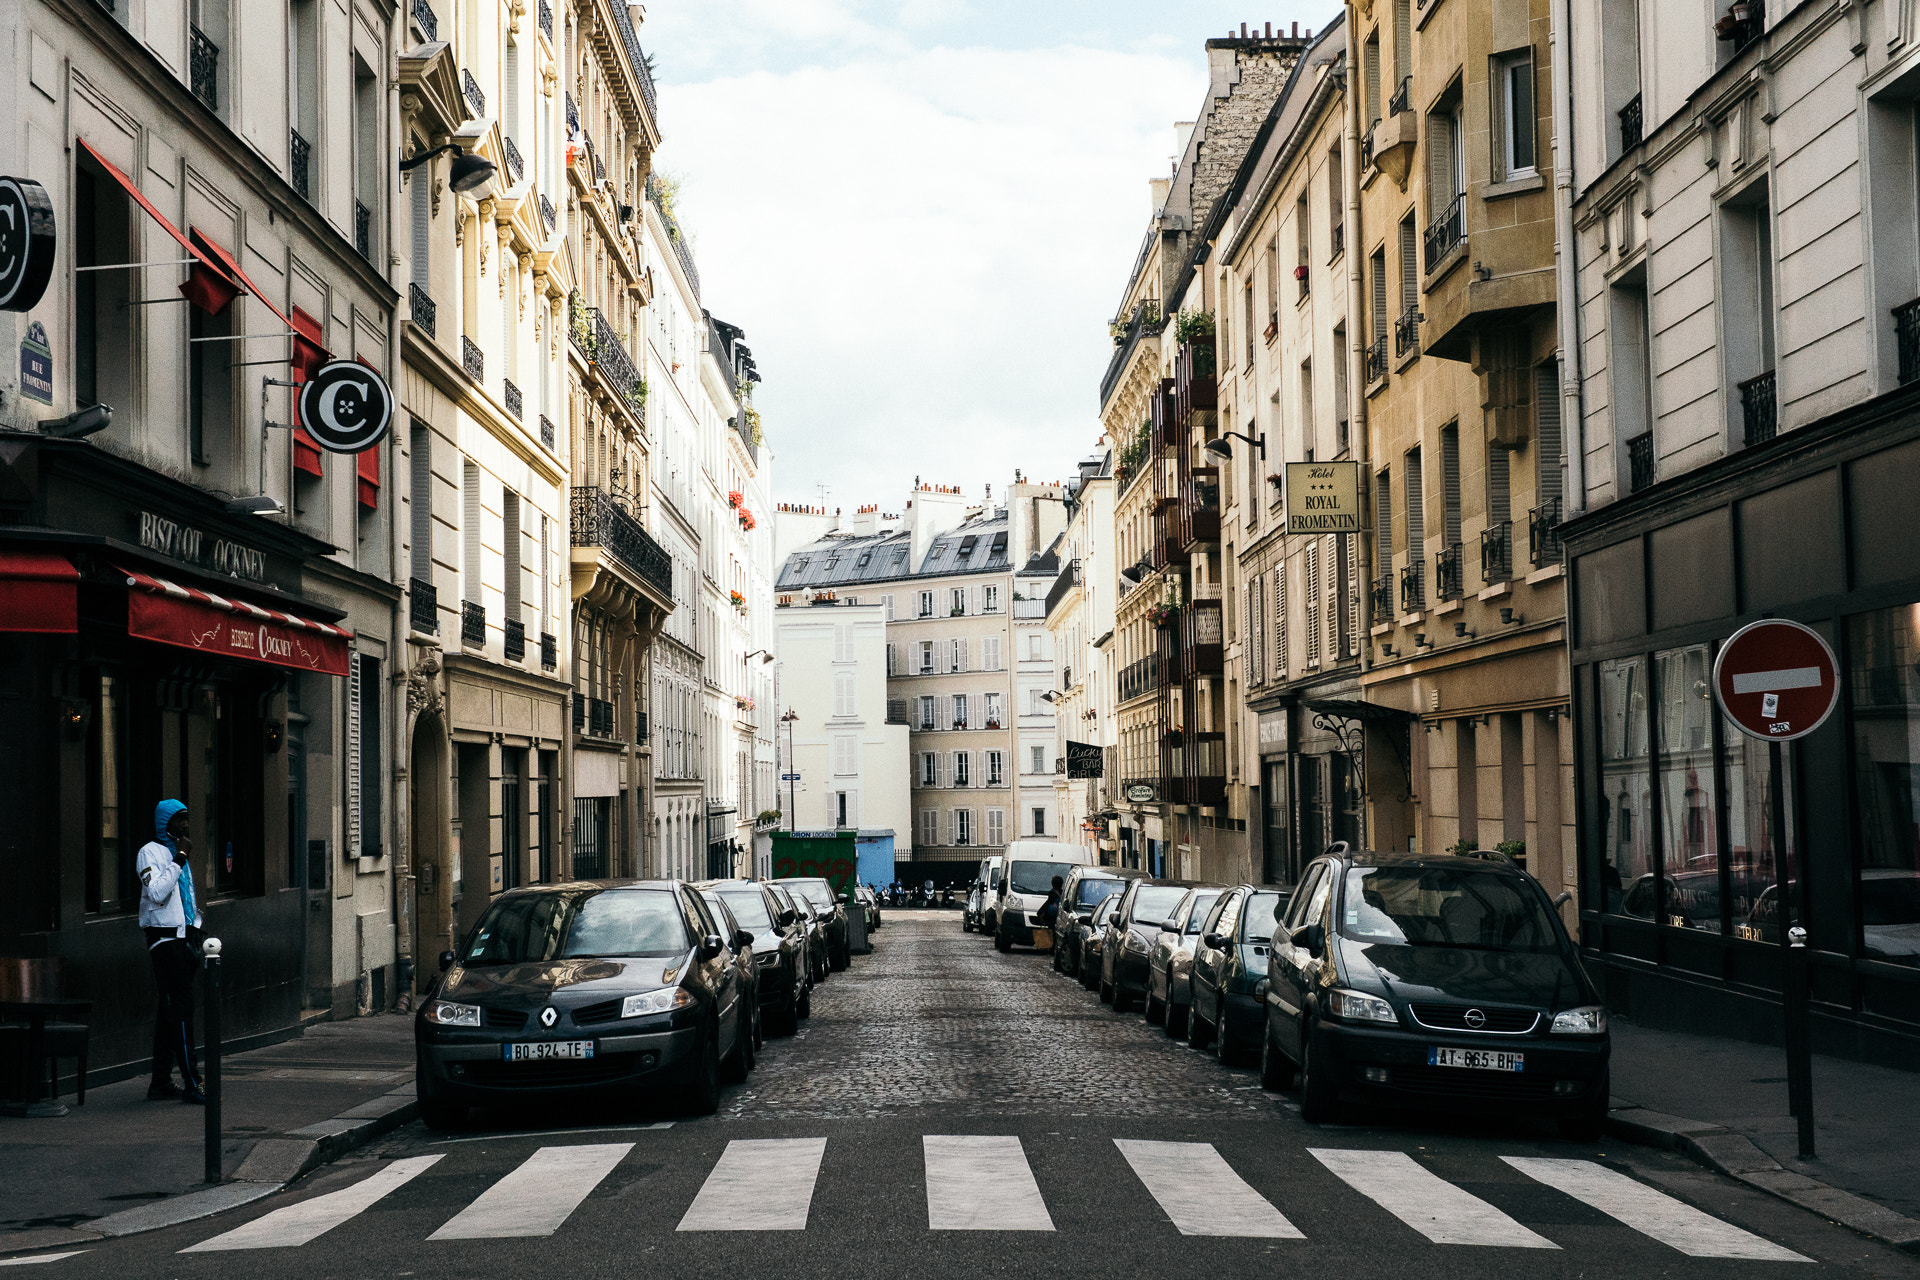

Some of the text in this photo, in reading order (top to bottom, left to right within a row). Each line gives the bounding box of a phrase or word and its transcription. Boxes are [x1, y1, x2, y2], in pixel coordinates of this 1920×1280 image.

[31, 360, 43, 375] RUE
[22, 372, 52, 393] FROMENTIN
[318, 379, 369, 433] C
[1307, 467, 1336, 479] Hôtel
[1305, 495, 1341, 509] ROYAL
[1291, 514, 1355, 530] FROMENTIN
[231, 628, 255, 650] BISTROT
[1082, 760, 1101, 769] BAR
[1068, 769, 1102, 779] GIRLS
[586, 1050, 594, 1058] 78
